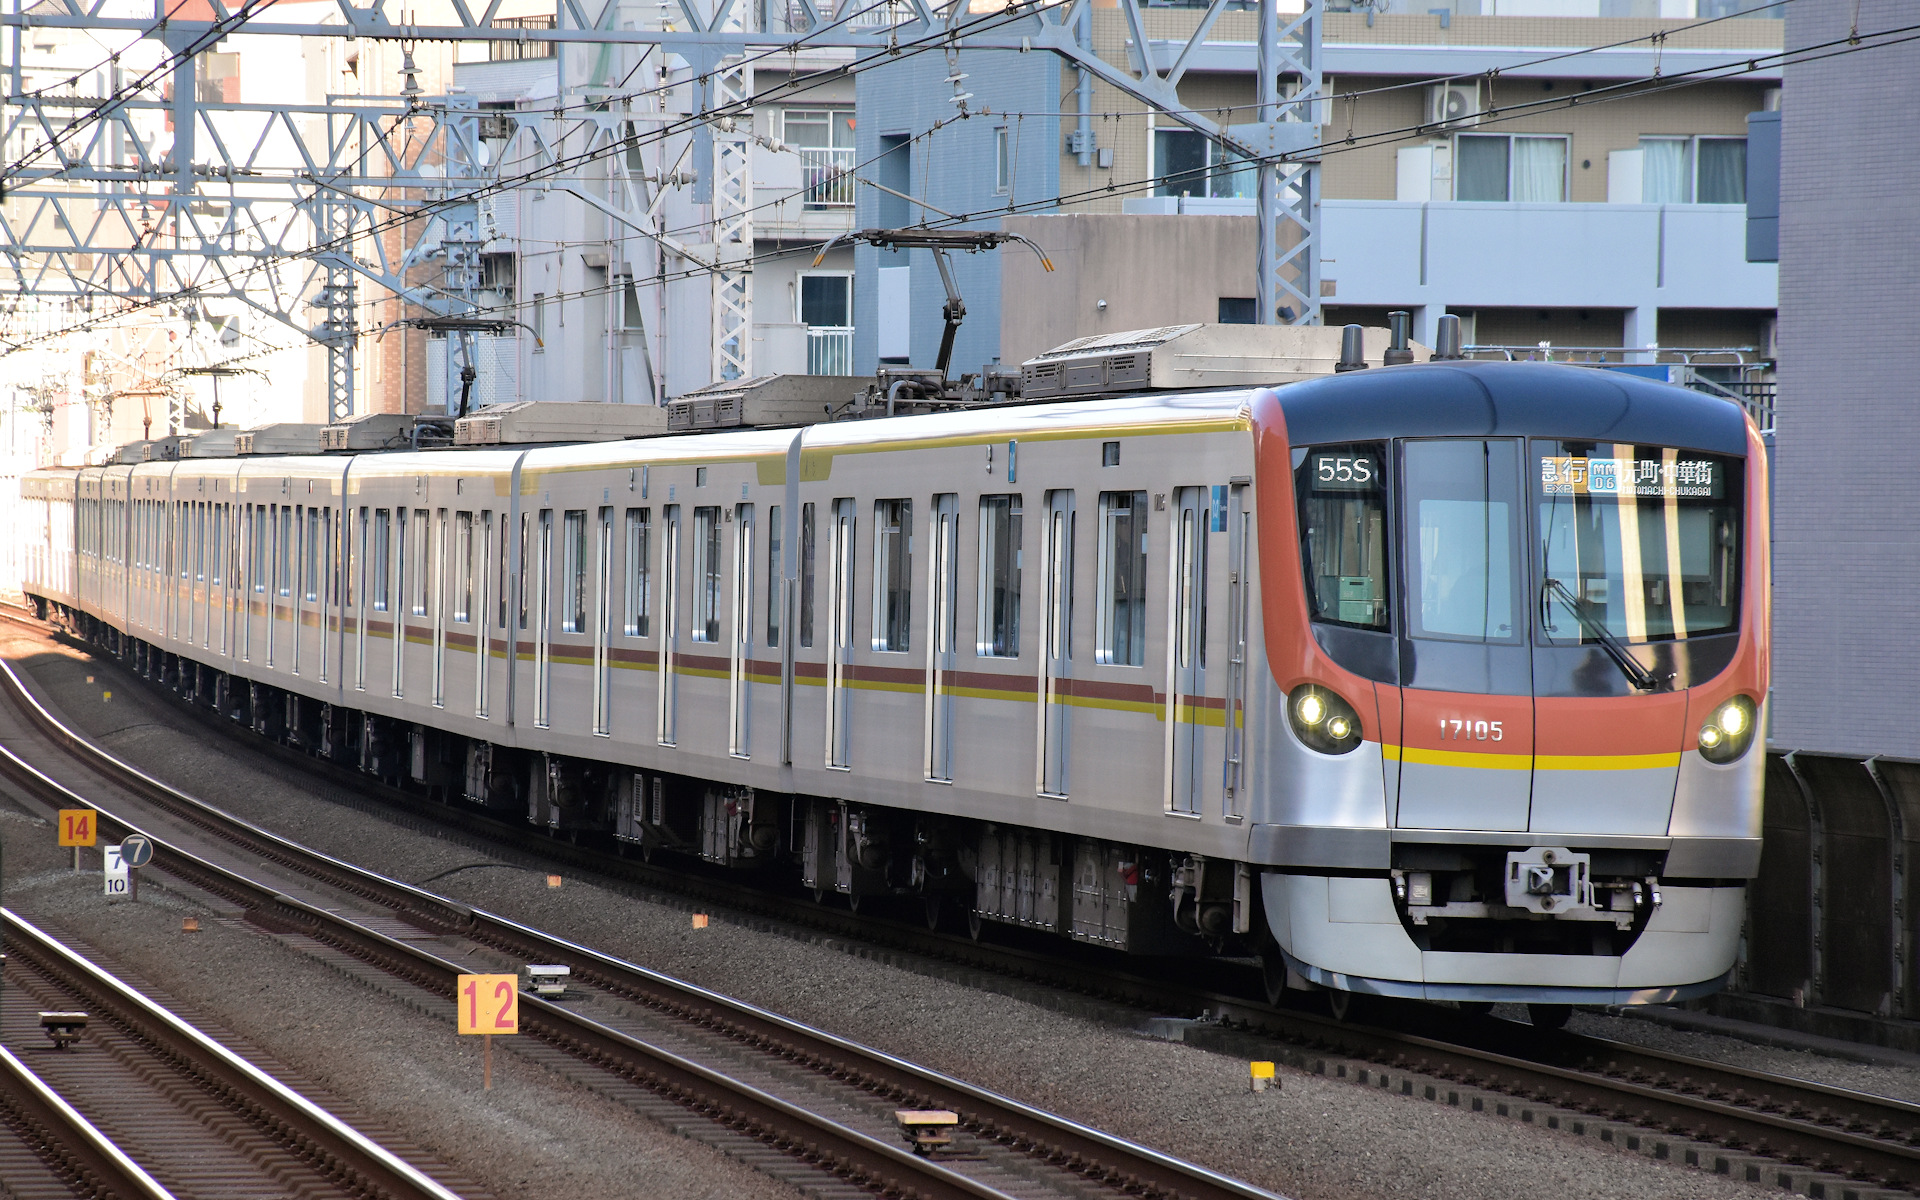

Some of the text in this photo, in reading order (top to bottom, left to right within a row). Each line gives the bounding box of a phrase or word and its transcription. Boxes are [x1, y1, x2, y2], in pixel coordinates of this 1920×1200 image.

[1318, 457, 1371, 482] 55S
[1541, 458, 1586, 483] 急行
[1593, 463, 1617, 475] MM
[1595, 477, 1615, 489] 06
[1440, 719, 1503, 741] 17105
[65, 815, 89, 840] 14
[108, 850, 121, 870] 7
[127, 838, 145, 863] 7
[107, 878, 125, 893] 10
[463, 980, 515, 1029] 12
